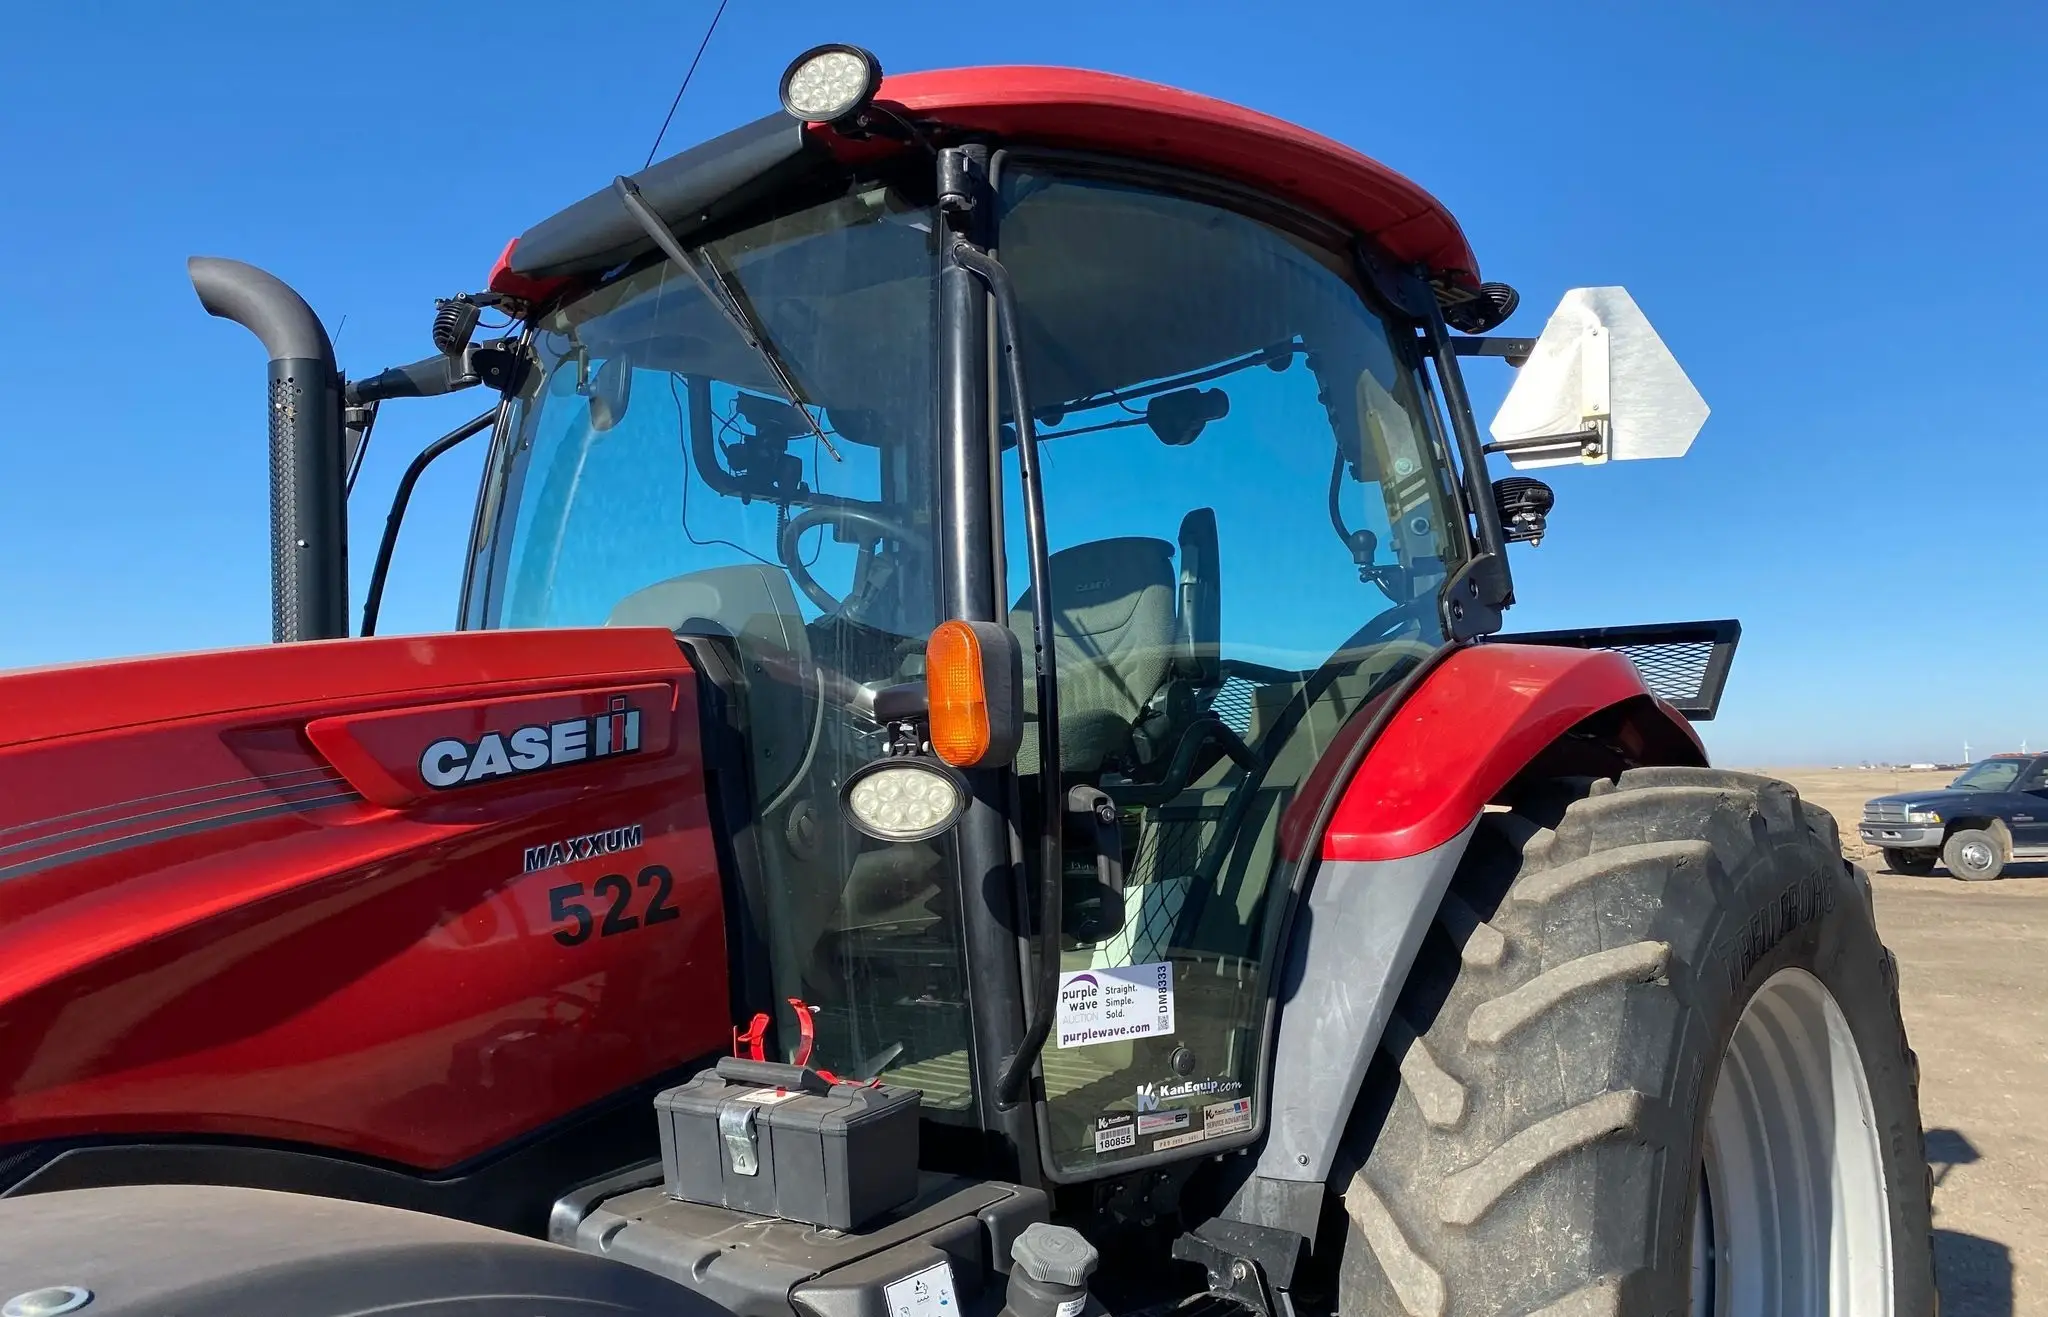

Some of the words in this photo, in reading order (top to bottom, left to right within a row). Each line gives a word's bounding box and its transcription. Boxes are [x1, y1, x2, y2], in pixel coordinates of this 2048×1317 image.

[420, 719, 588, 787] CASE
[523, 824, 643, 873] MAXXUM
[547, 864, 680, 947] 522
[1062, 985, 1098, 1002] purple
[1105, 984, 1138, 995] Straight.
[1157, 965, 1168, 1013] DM8333
[1069, 1000, 1098, 1011] wave
[1105, 996, 1134, 1007] Simple.
[1063, 1012, 1099, 1024] AUCTION
[1106, 1009, 1125, 1019] Sold.
[1063, 1023, 1150, 1045] purplewave.com
[1100, 1135, 1132, 1149] 180855
